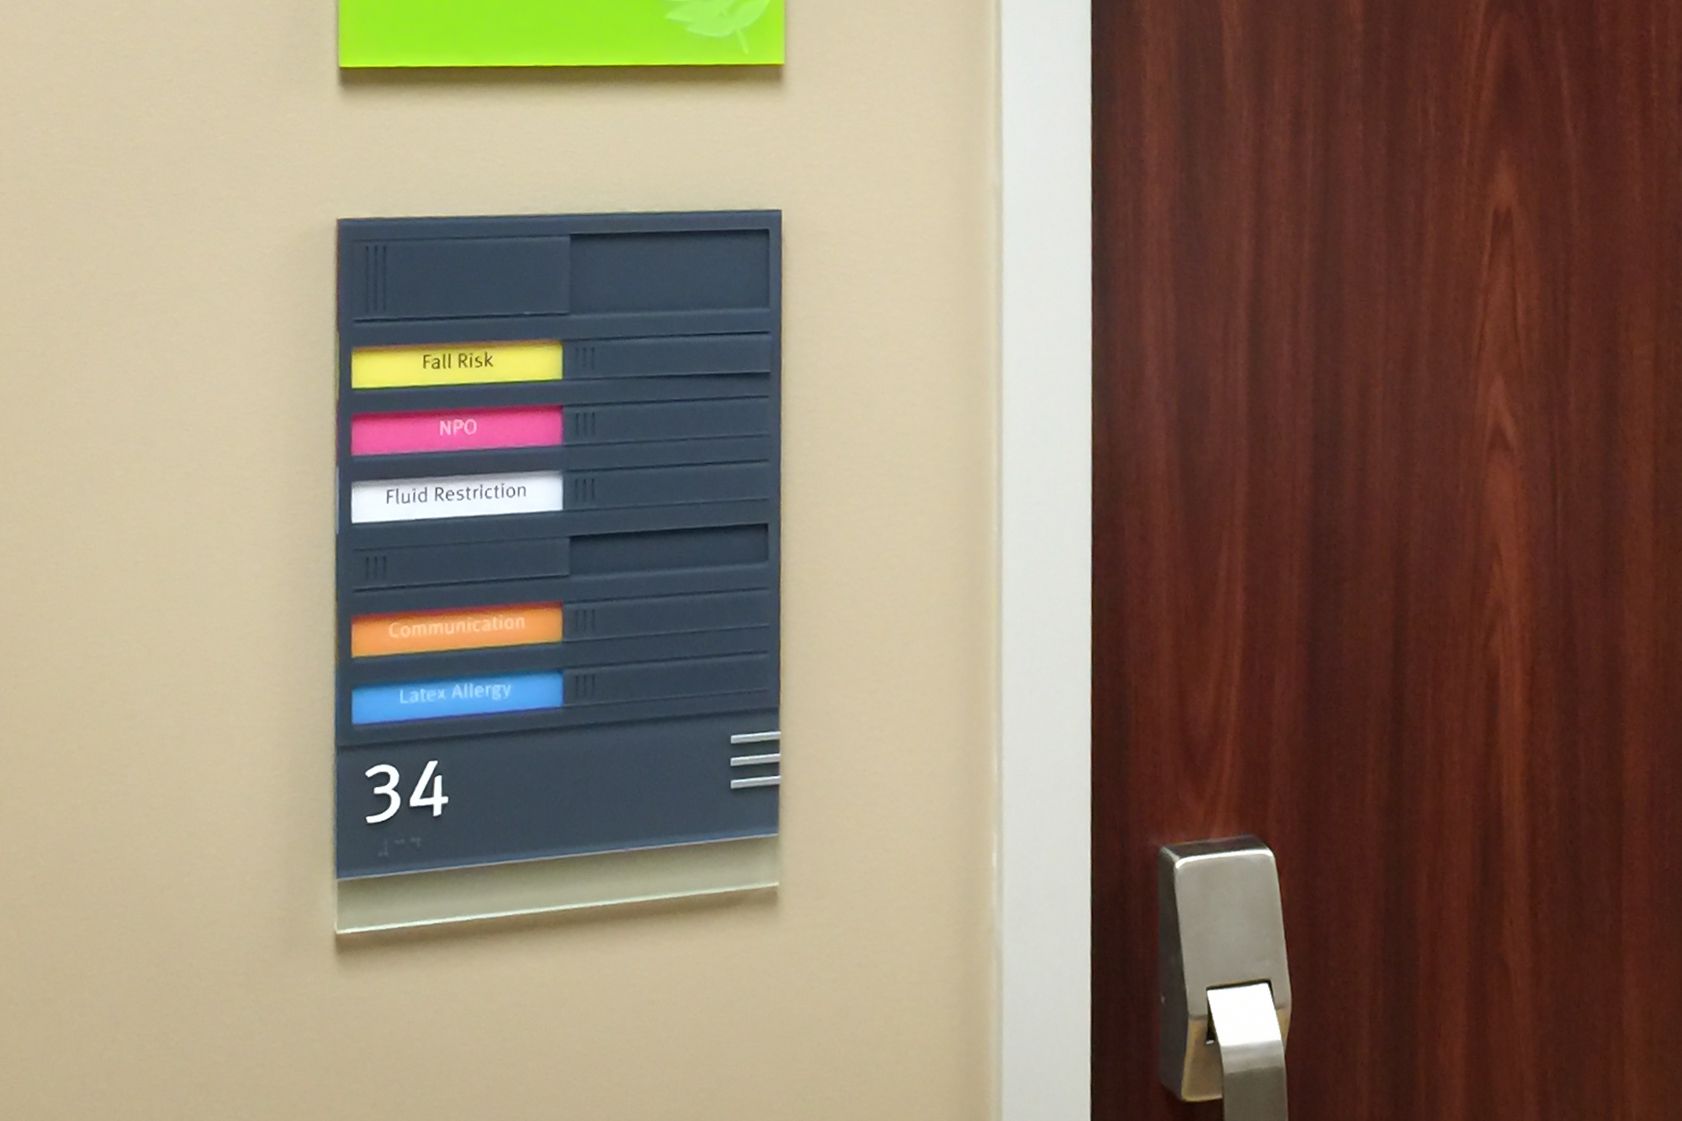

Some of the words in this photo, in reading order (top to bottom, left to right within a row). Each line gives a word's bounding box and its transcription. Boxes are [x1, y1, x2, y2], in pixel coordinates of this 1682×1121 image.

[422, 353, 452, 371] Fall
[458, 351, 494, 370] Risk
[438, 418, 478, 437] NPO
[386, 485, 429, 505] Fluid
[434, 482, 527, 502] Restriction
[388, 614, 526, 639] Communication
[399, 686, 446, 705] Latex
[452, 681, 512, 702] Allergy
[364, 759, 449, 824] 34
